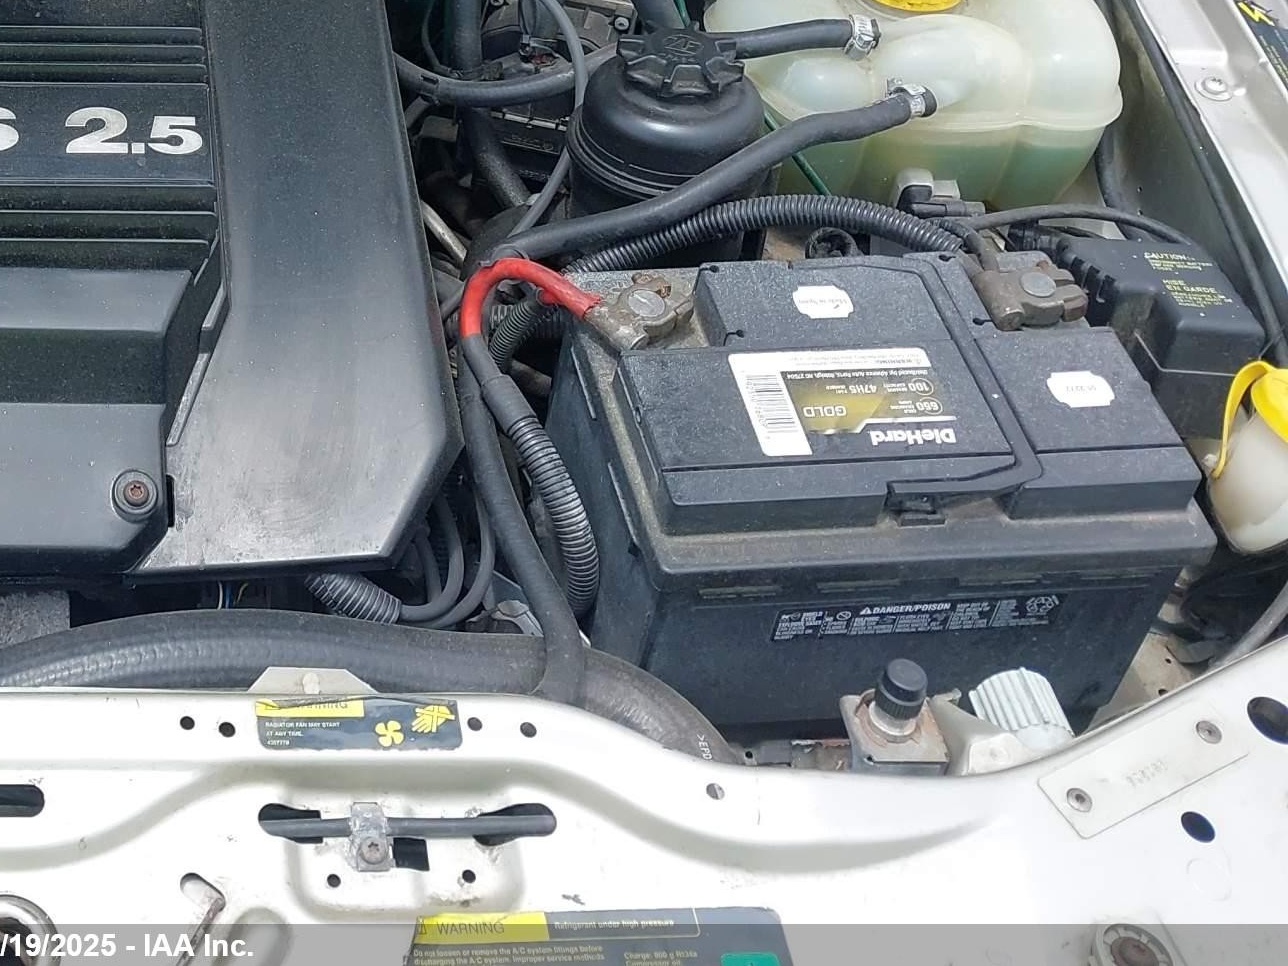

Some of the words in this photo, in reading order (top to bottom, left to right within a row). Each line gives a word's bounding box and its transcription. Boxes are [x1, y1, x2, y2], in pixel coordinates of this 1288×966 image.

[65, 106, 203, 154] 2.5
[849, 384, 877, 395] 47H5
[910, 381, 929, 393] 100
[802, 405, 847, 418] GOLD
[870, 428, 957, 445] DieHard
[872, 602, 952, 614] DANGER/POISON
[436, 921, 505, 935] WARNING
[554, 921, 598, 931] Refrigerant
[598, 920, 621, 929] under
[621, 919, 639, 930] high
[640, 919, 675, 930] pressure
[413, 949, 423, 957] Do
[498, 947, 511, 955] the
